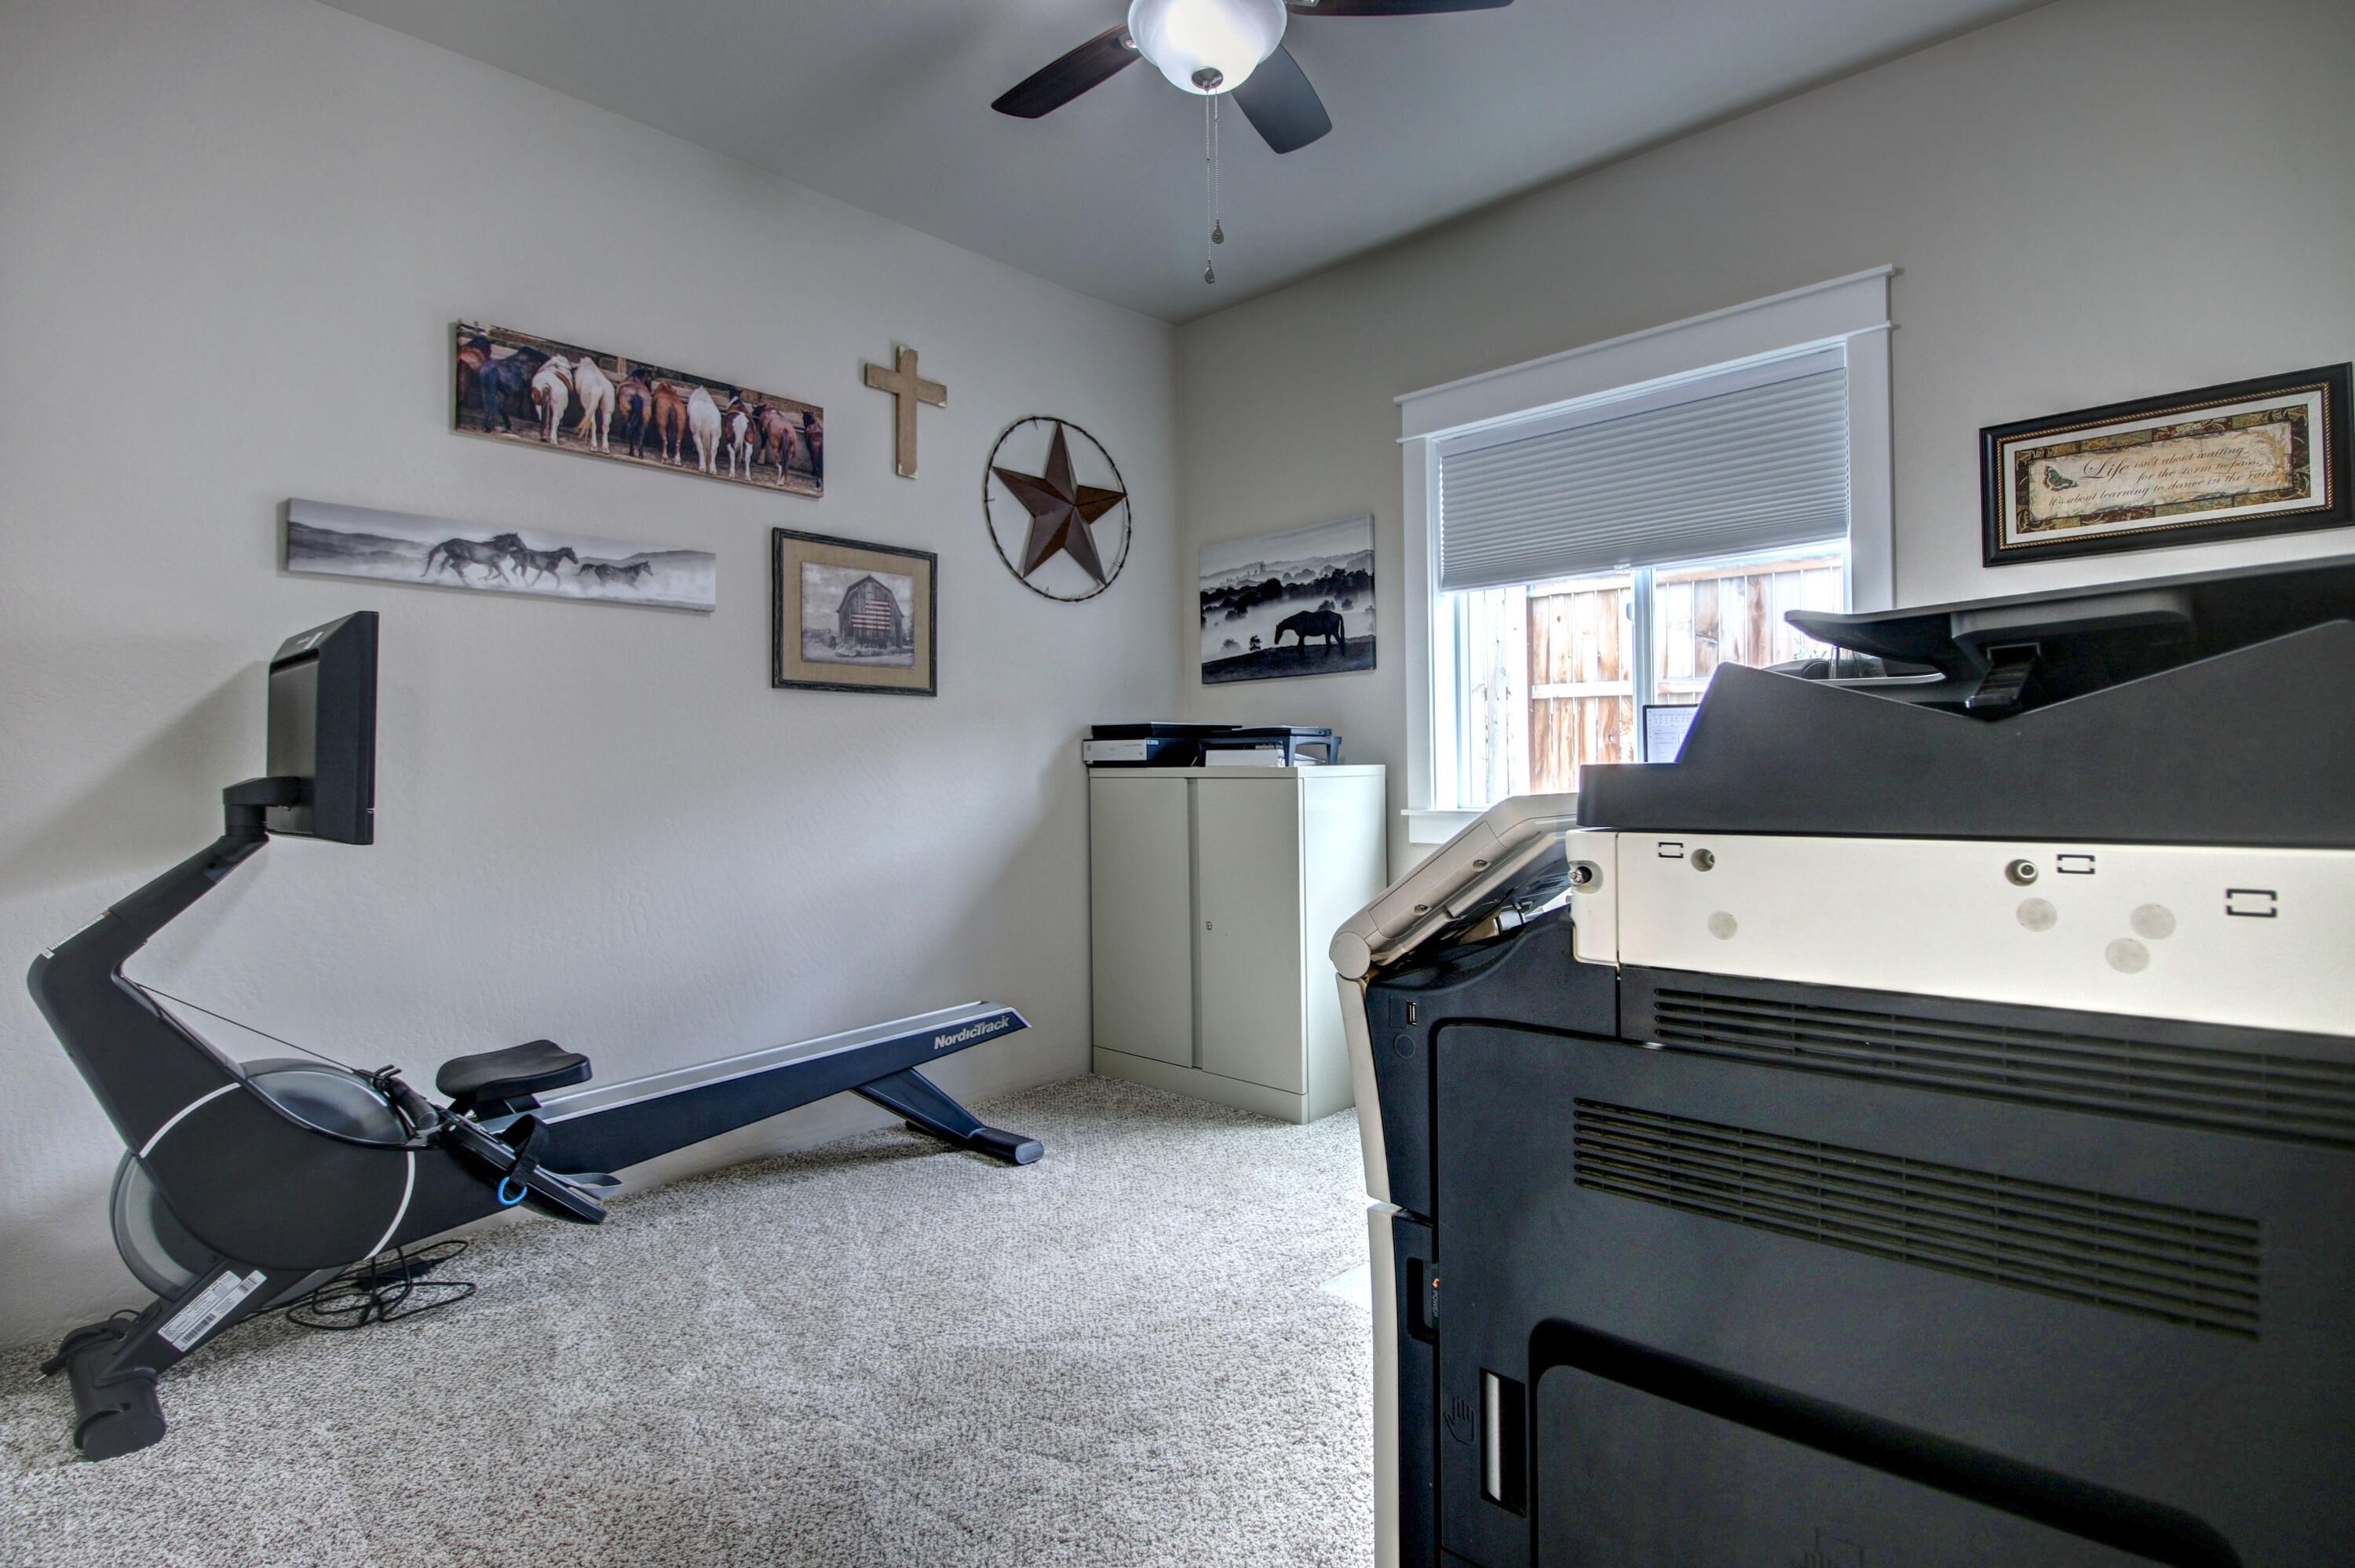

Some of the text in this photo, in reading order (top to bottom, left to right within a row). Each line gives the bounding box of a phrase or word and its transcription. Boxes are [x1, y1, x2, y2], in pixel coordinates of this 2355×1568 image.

[2080, 447, 2244, 484] Life isn't about waiting
[2136, 472, 2155, 484] for
[2157, 469, 2175, 478] the
[2178, 466, 2211, 476] storm
[2067, 493, 2097, 504] about
[2100, 486, 2149, 499] learning
[2167, 480, 2203, 490] dance
[2225, 472, 2243, 483] the
[934, 1016, 1010, 1050] NordicTrack
